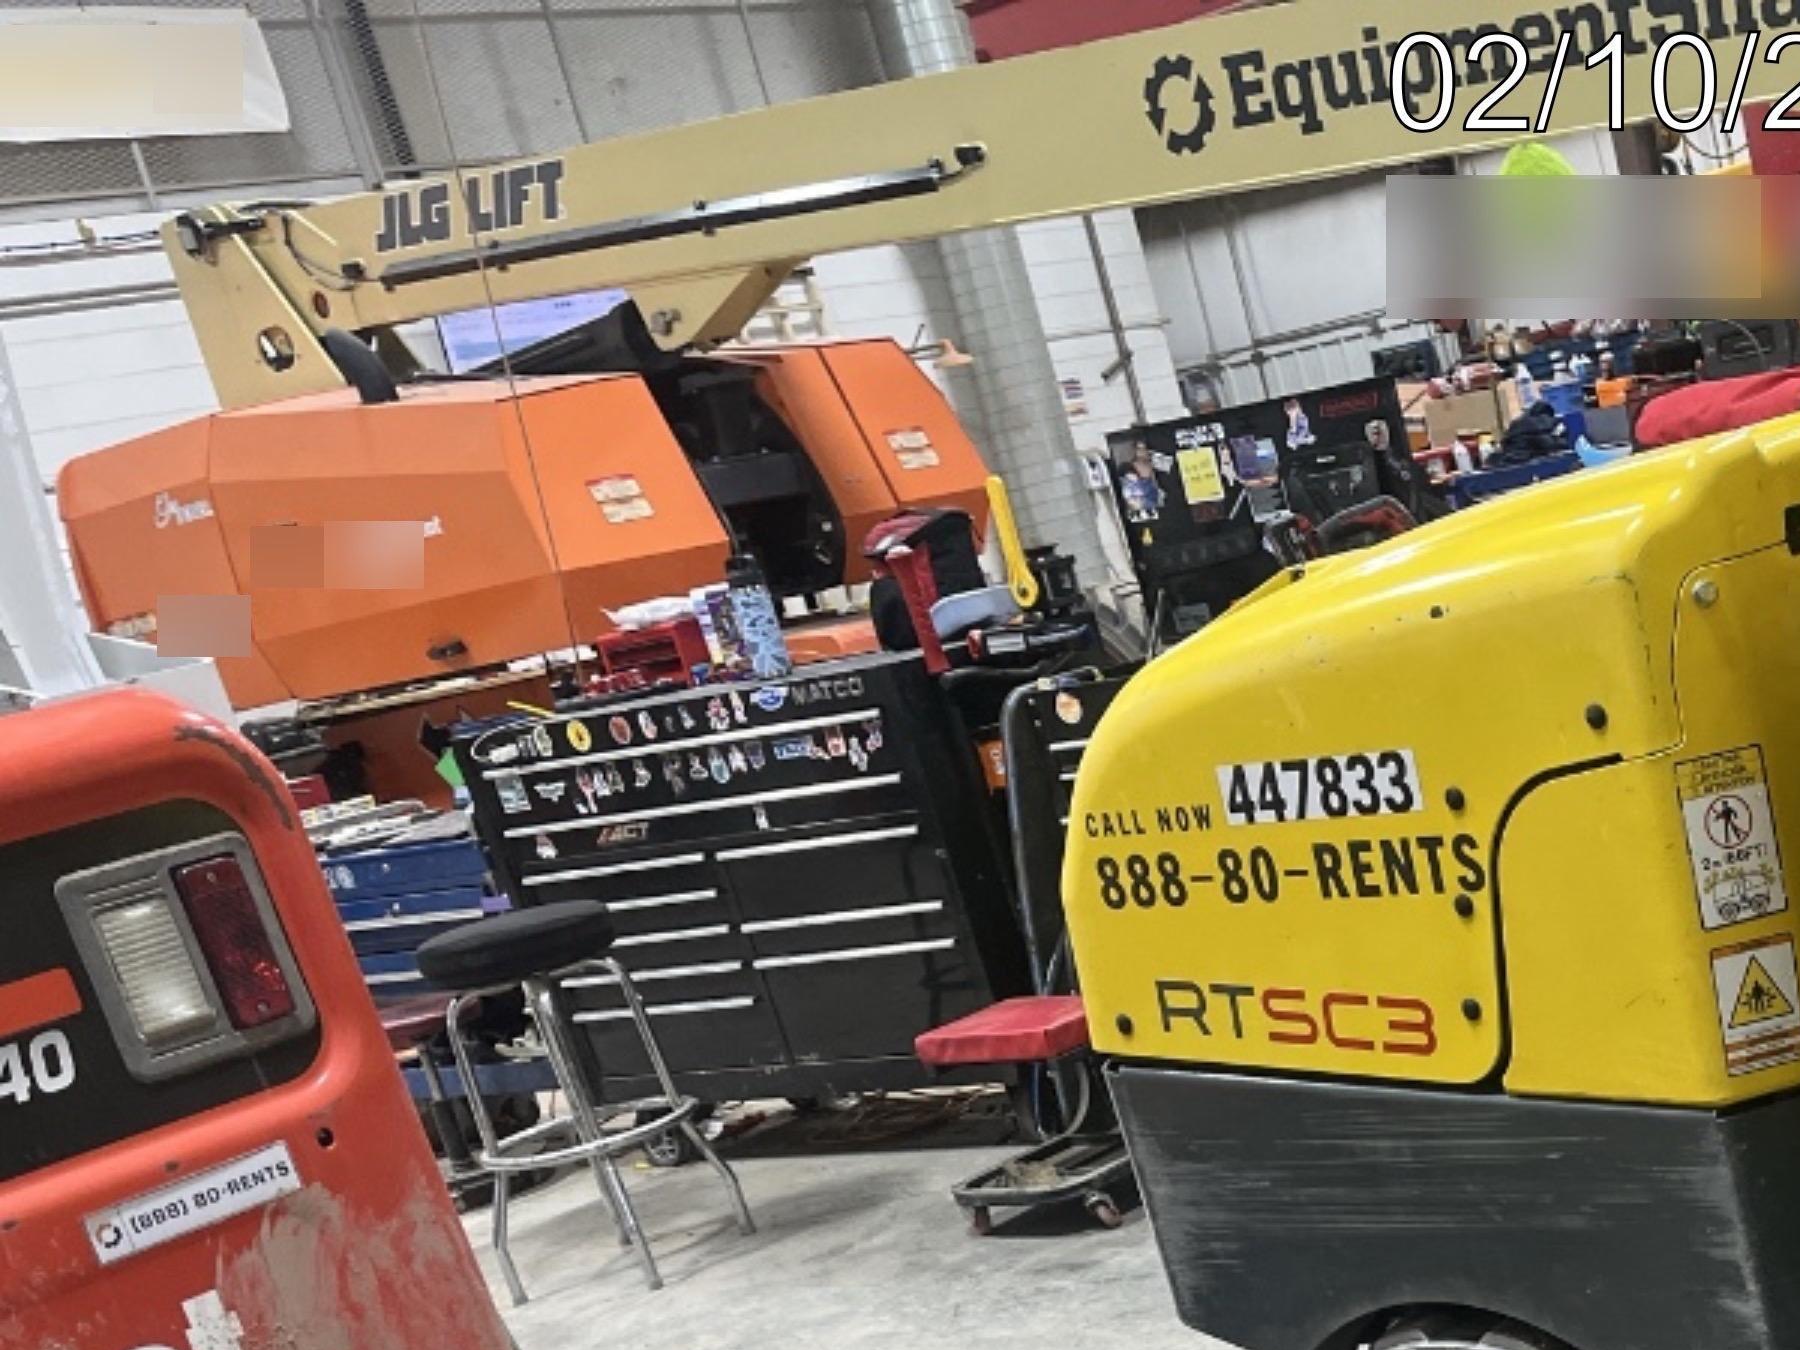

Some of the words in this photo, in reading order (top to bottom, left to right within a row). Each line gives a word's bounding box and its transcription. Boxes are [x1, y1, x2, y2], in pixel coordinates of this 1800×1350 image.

[376, 182, 450, 253] JLG
[466, 159, 566, 234] LIFT
[1085, 809, 1147, 838] CALL
[1157, 804, 1212, 832] NOW
[1228, 750, 1414, 825] 447833
[1097, 833, 1486, 910] 888-80-RENTS
[1155, 979, 1438, 1058] RTSC3
[0, 1029, 76, 1105] 40
